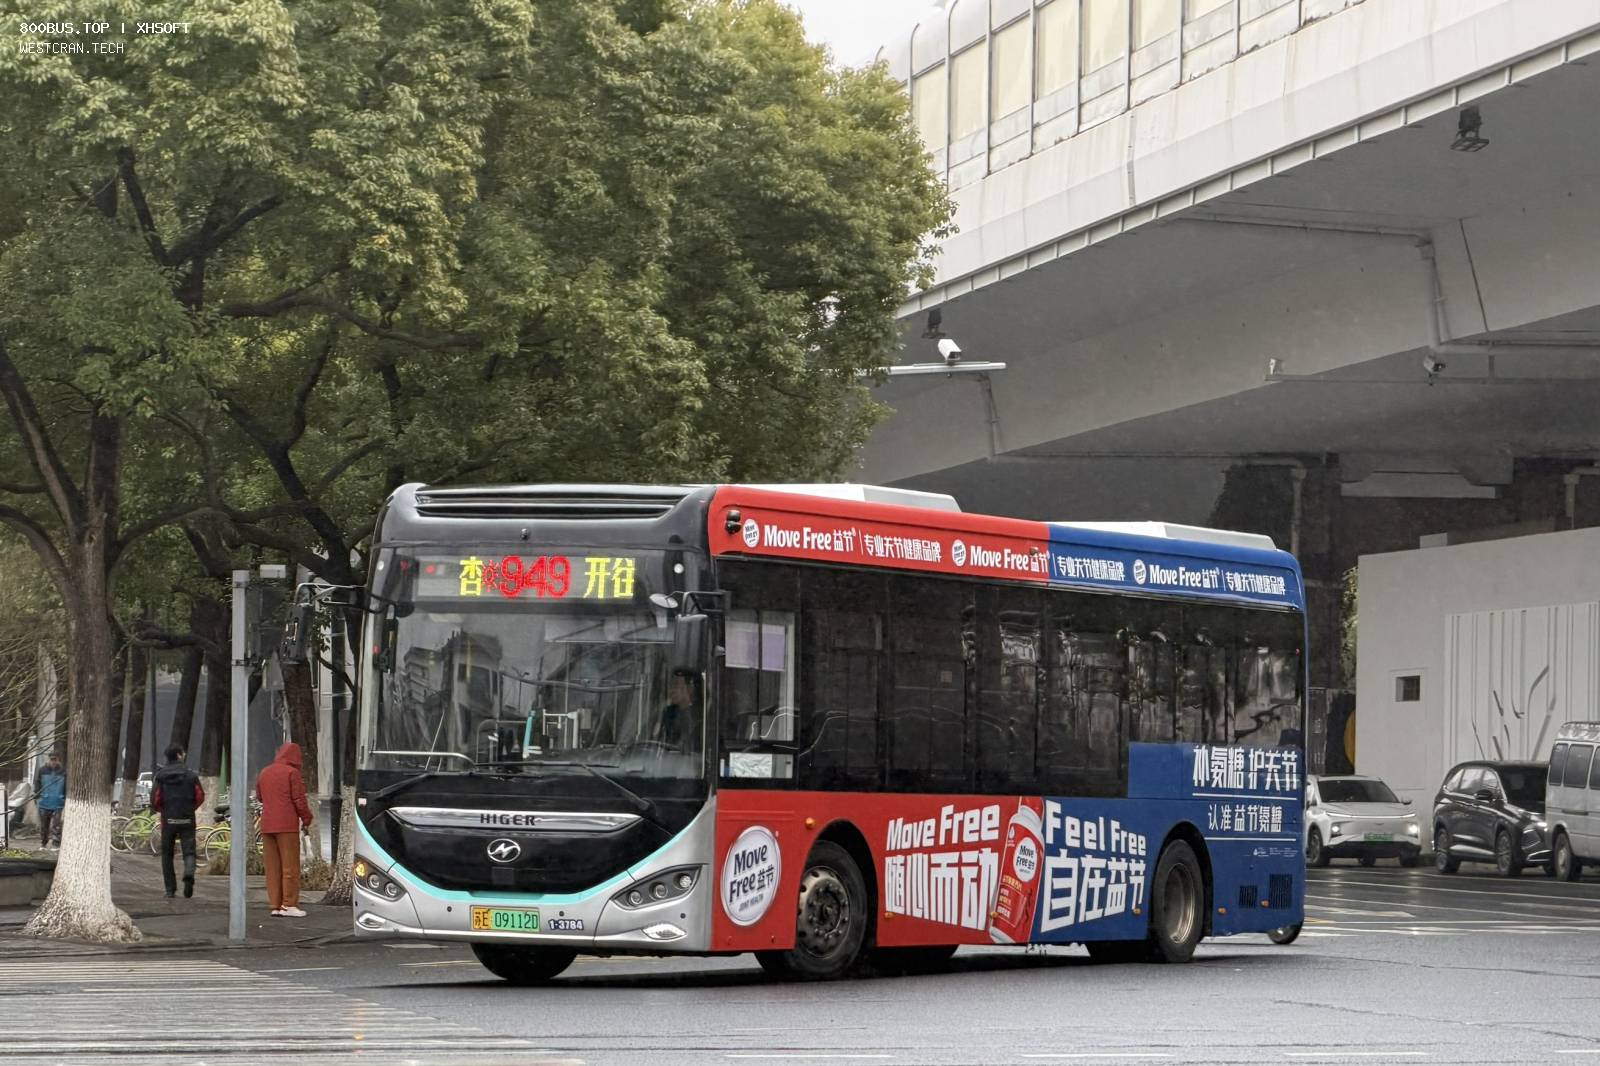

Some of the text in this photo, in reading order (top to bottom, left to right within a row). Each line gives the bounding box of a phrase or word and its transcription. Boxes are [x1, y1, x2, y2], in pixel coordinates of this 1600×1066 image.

[764, 524, 800, 548] Move
[803, 527, 831, 550] Free
[864, 533, 941, 563] 专业关节健康品牌
[970, 545, 1002, 568] Move
[1004, 548, 1029, 571] Free
[1057, 555, 1126, 581] 专业关节健康品牌
[500, 555, 571, 599] 949
[1149, 564, 1177, 585] Move
[1179, 567, 1202, 587] Free
[1193, 745, 1297, 791] 补氨糖 护关节
[480, 813, 536, 826] HIGER
[886, 804, 1000, 851] Move Free
[1046, 799, 1147, 856] Feel Free
[734, 845, 767, 875] Move
[729, 873, 756, 903] Free
[885, 848, 999, 931] 随心而动
[1041, 848, 1146, 933] 自在益节
[549, 919, 584, 931] 1-3784
